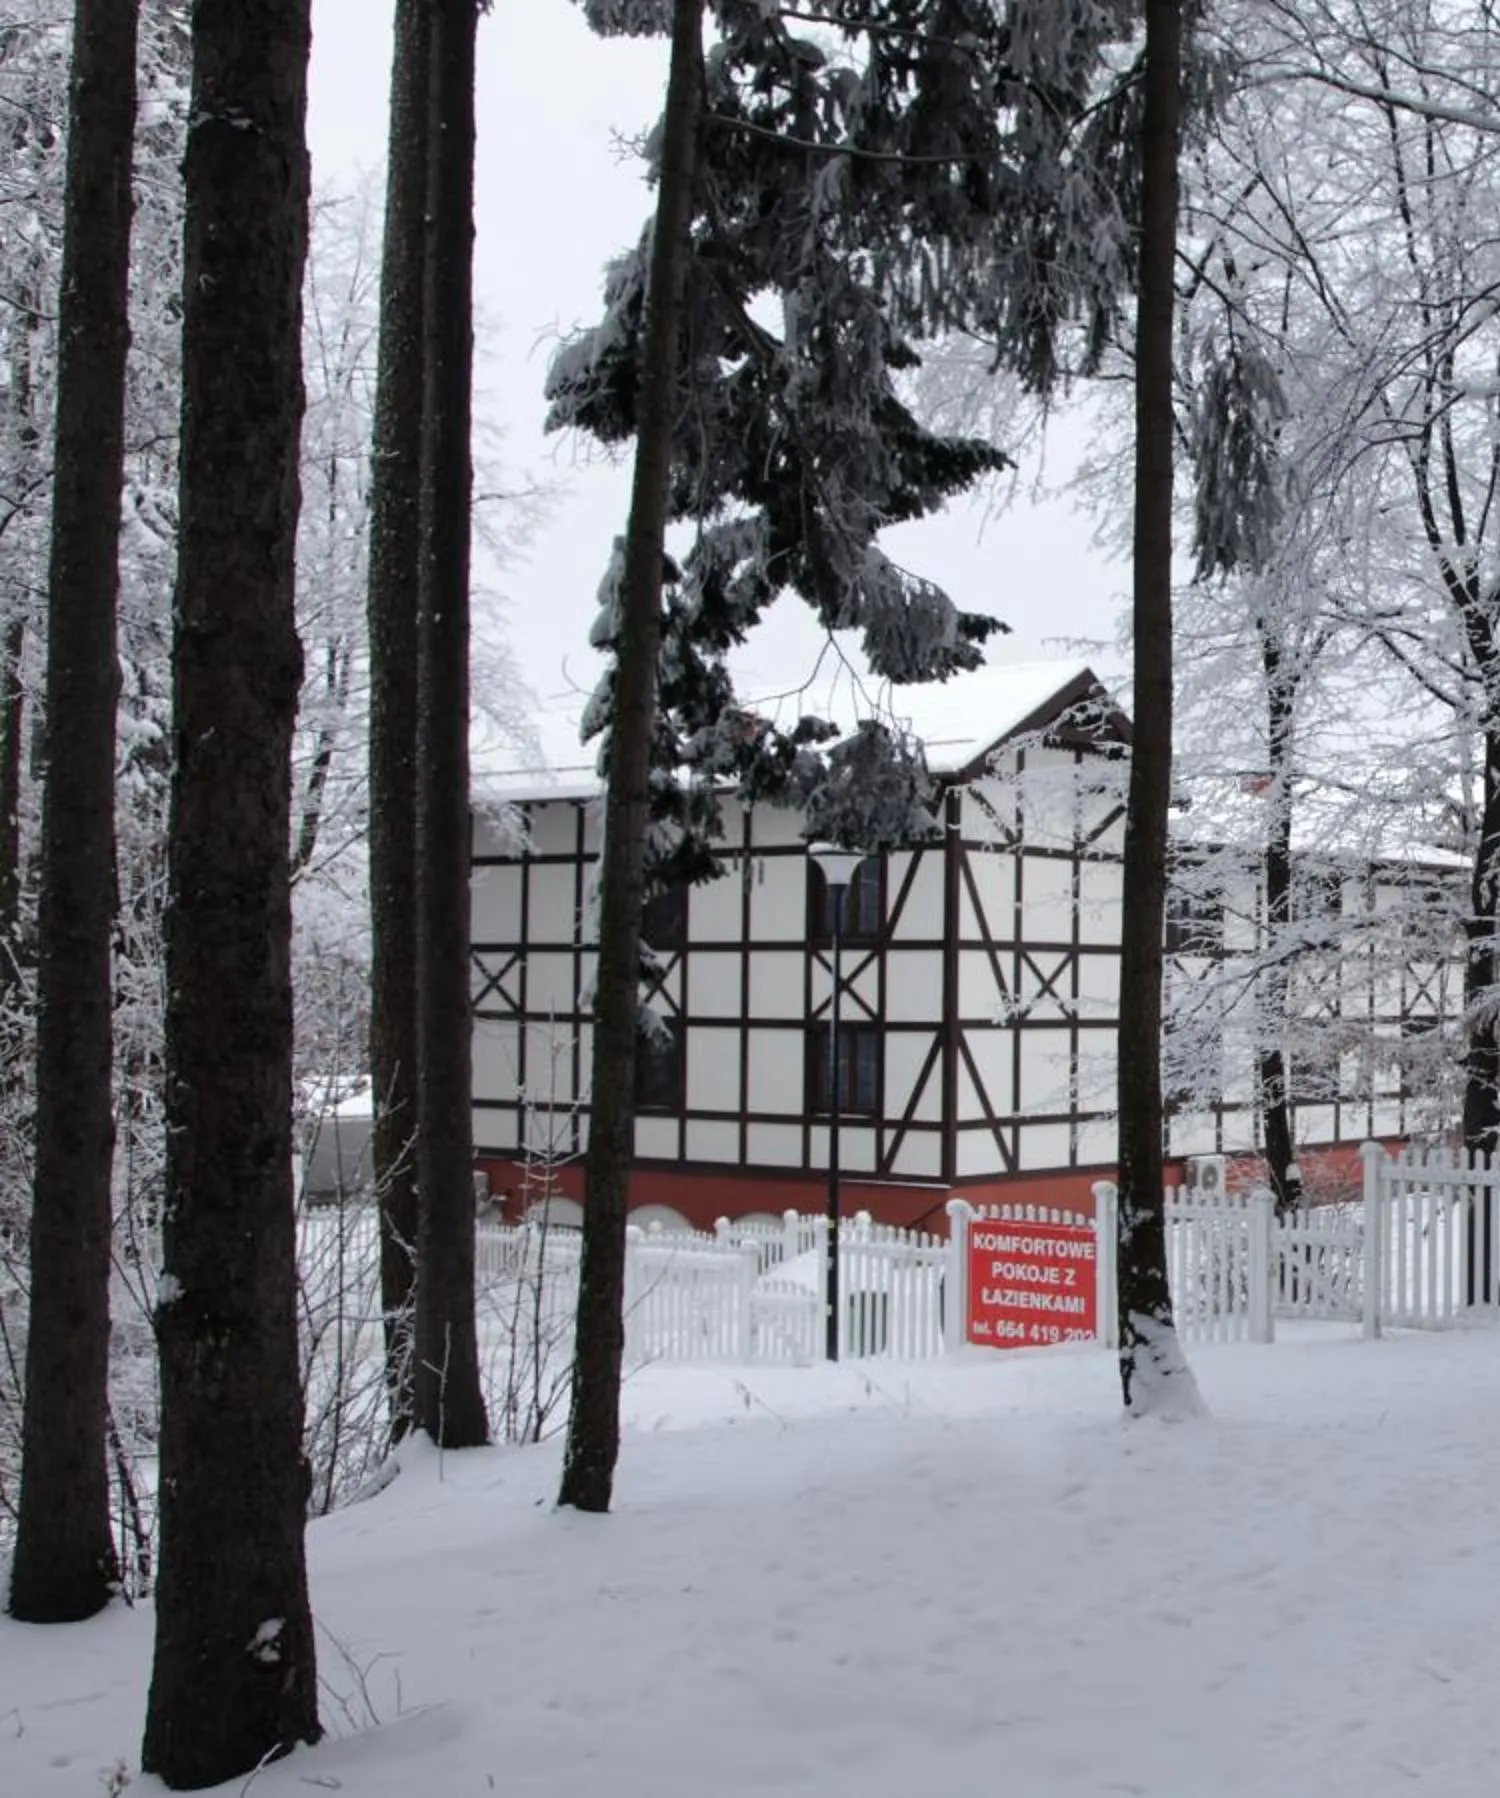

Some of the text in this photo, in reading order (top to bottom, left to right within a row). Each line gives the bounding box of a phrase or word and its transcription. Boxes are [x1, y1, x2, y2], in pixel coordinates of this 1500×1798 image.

[973, 1232, 1095, 1260] KOMFORTOWE
[991, 1261, 1076, 1286] POKOJE Z
[981, 1287, 1085, 1314] ŁAZIENKAMI
[1029, 1323, 1060, 1343] 419
